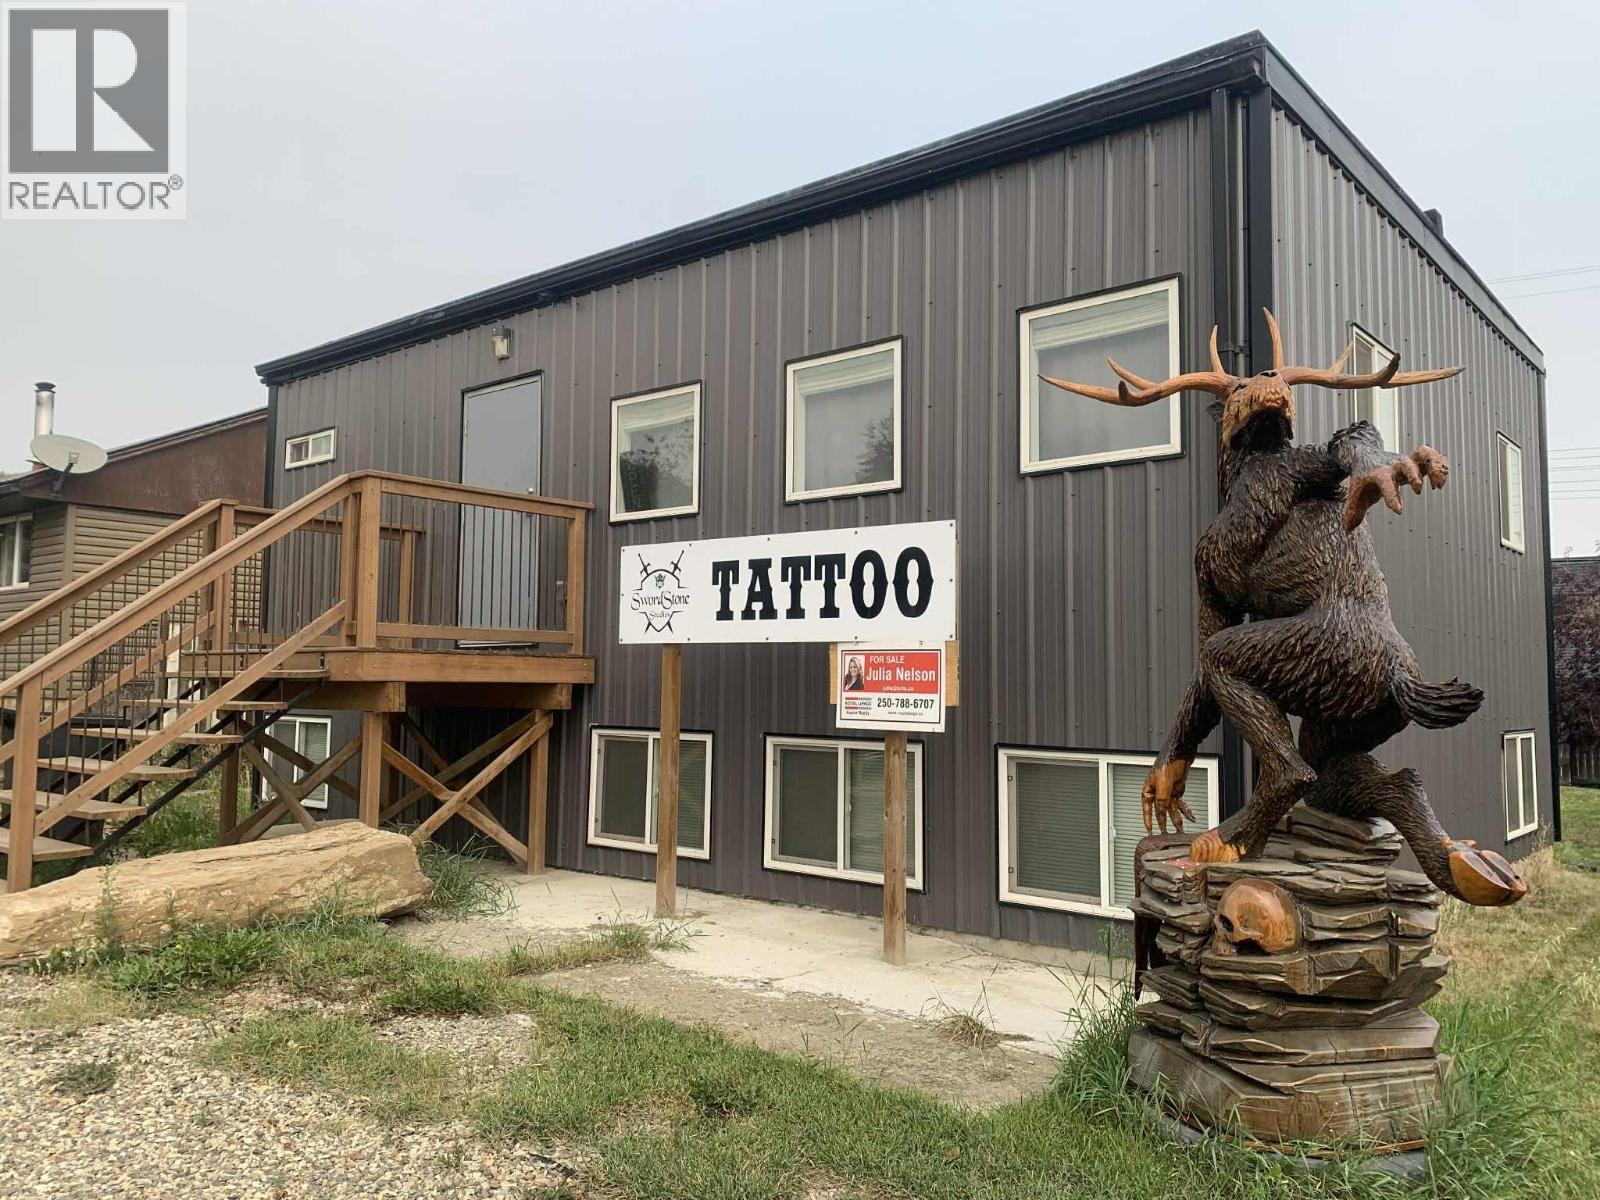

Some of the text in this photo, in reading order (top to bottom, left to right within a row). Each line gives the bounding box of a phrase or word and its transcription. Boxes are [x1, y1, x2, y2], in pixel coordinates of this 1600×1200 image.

[712, 546, 934, 621] TATTOO
[869, 656, 905, 664] FOR SALE
[866, 667, 936, 682] Julia Nelson
[877, 698, 935, 709] 250-788-6707
